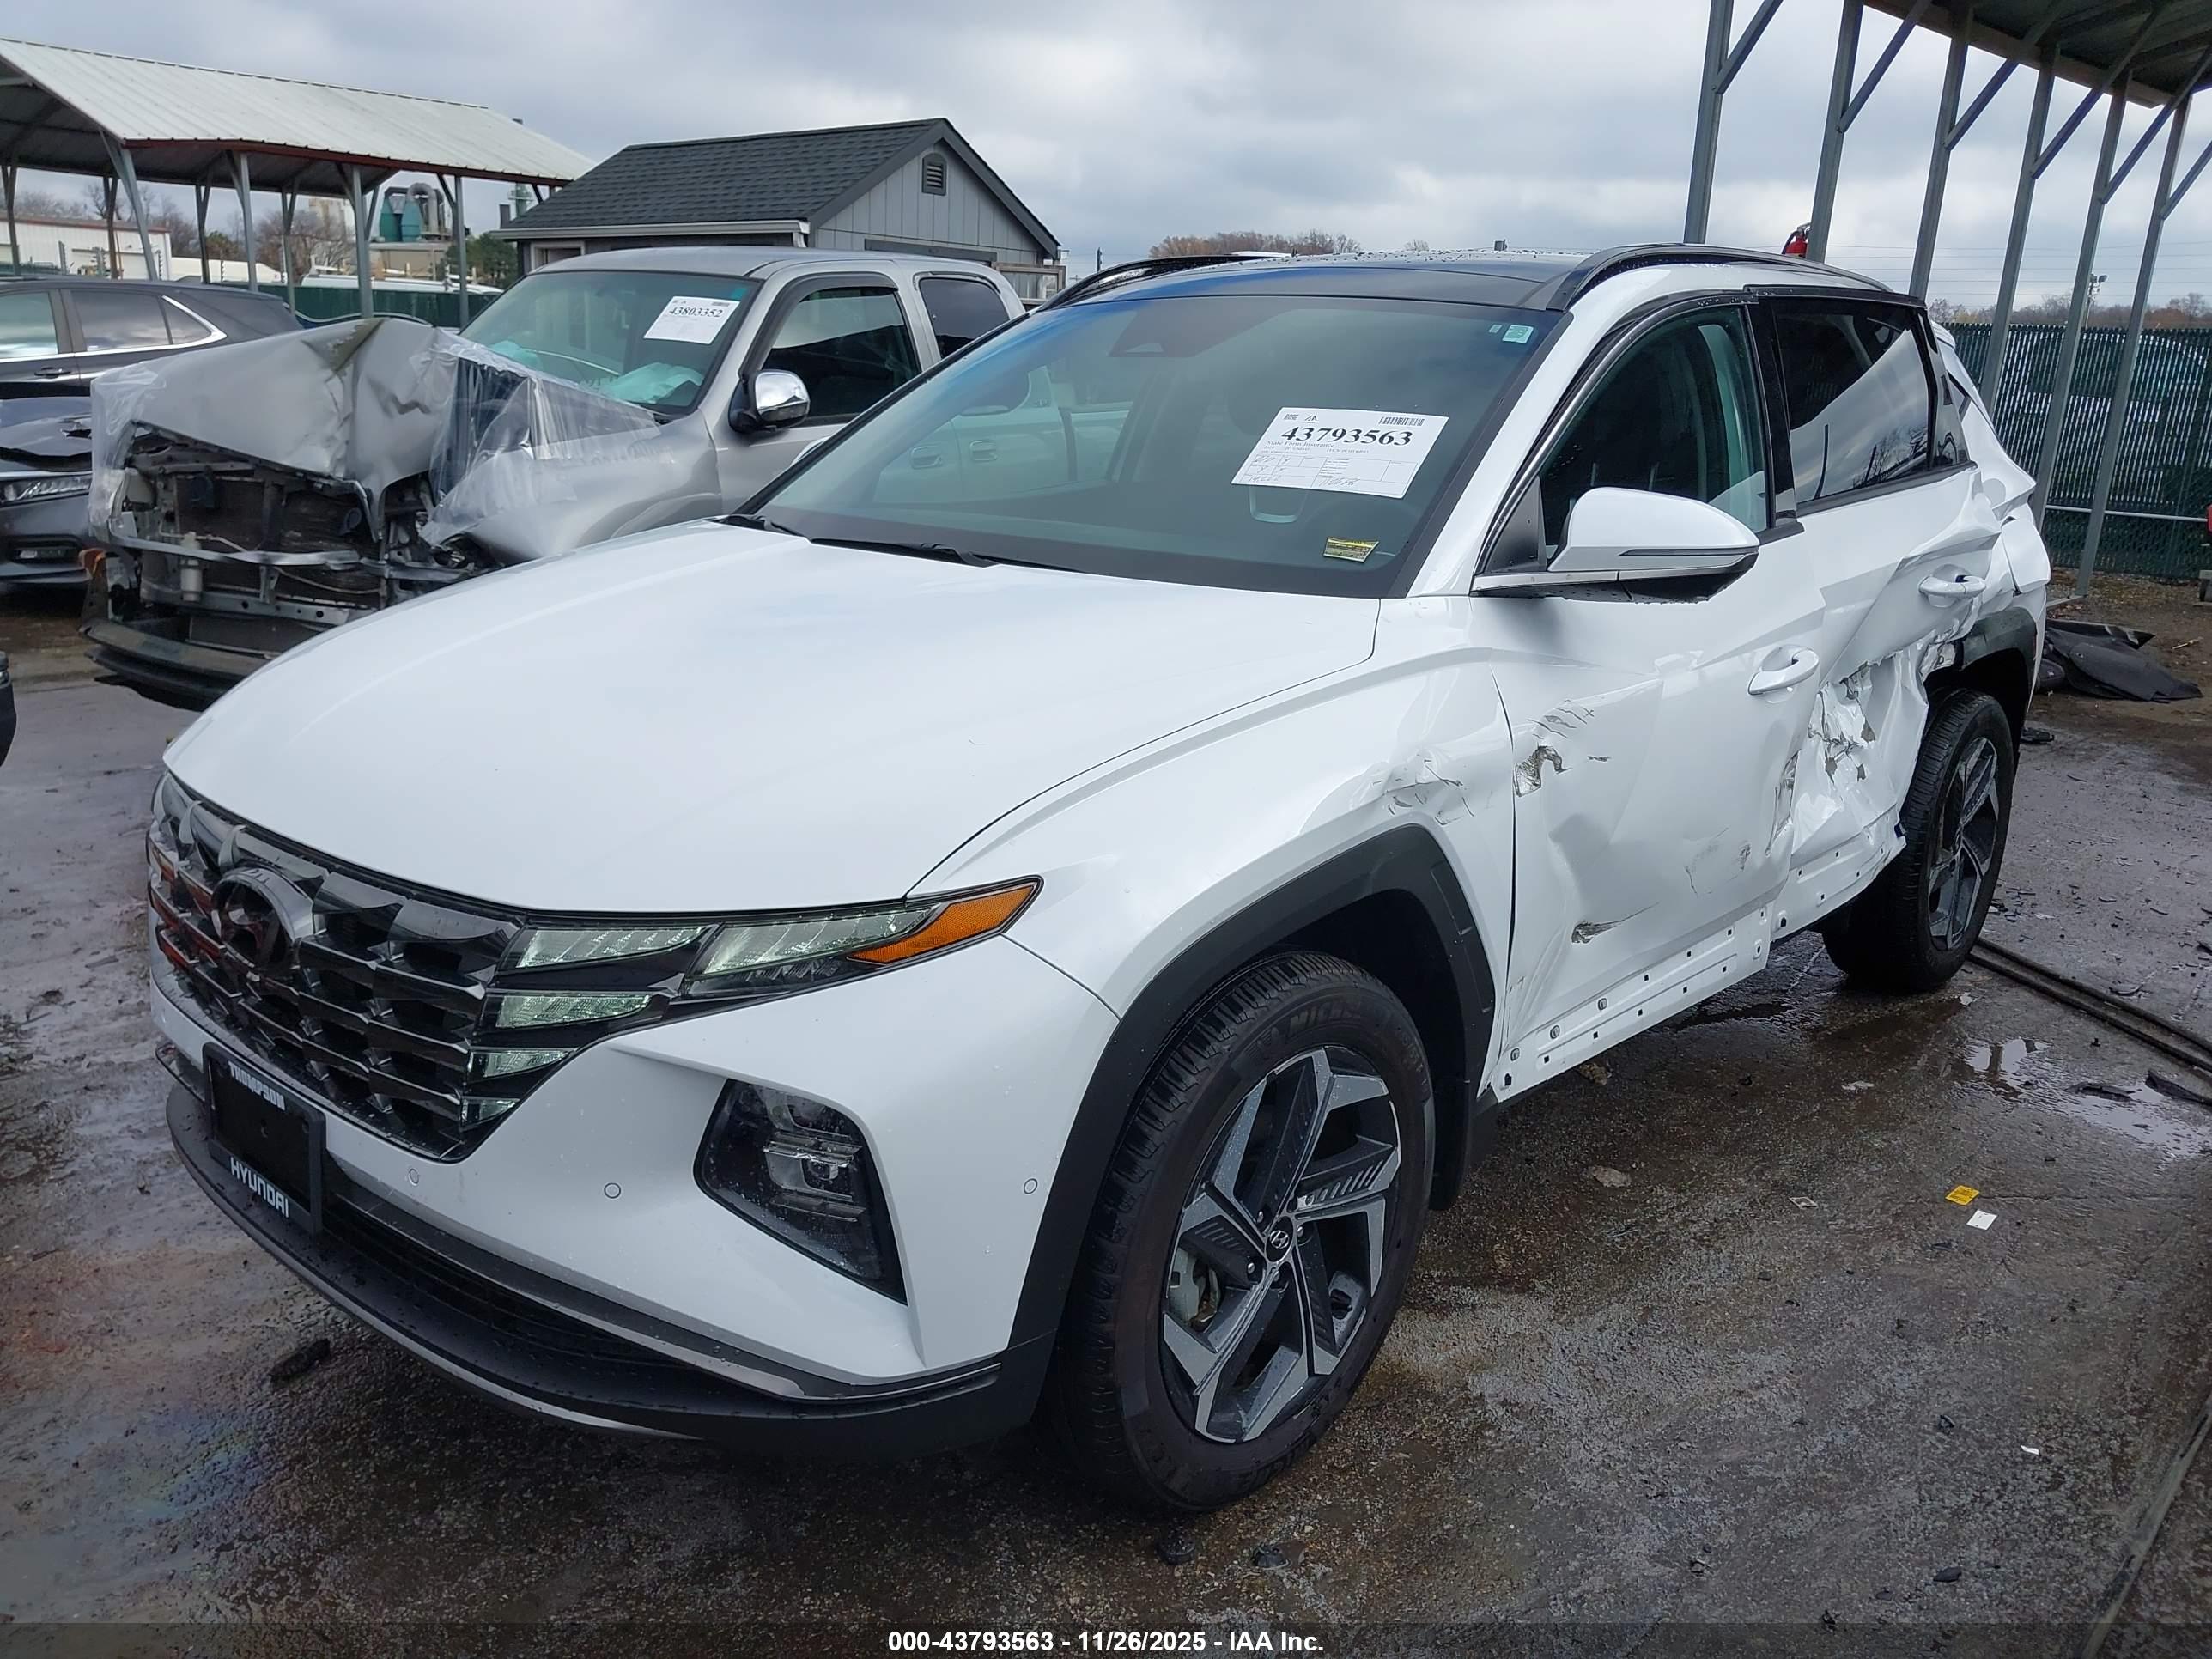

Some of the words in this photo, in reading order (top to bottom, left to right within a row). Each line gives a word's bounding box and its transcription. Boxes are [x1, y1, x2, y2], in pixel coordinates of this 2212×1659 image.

[669, 307, 724, 318] 43803352
[1281, 426, 1413, 446] 43793563
[228, 1060, 286, 1111] THOMPSON
[230, 1157, 289, 1218] HYUNDAI
